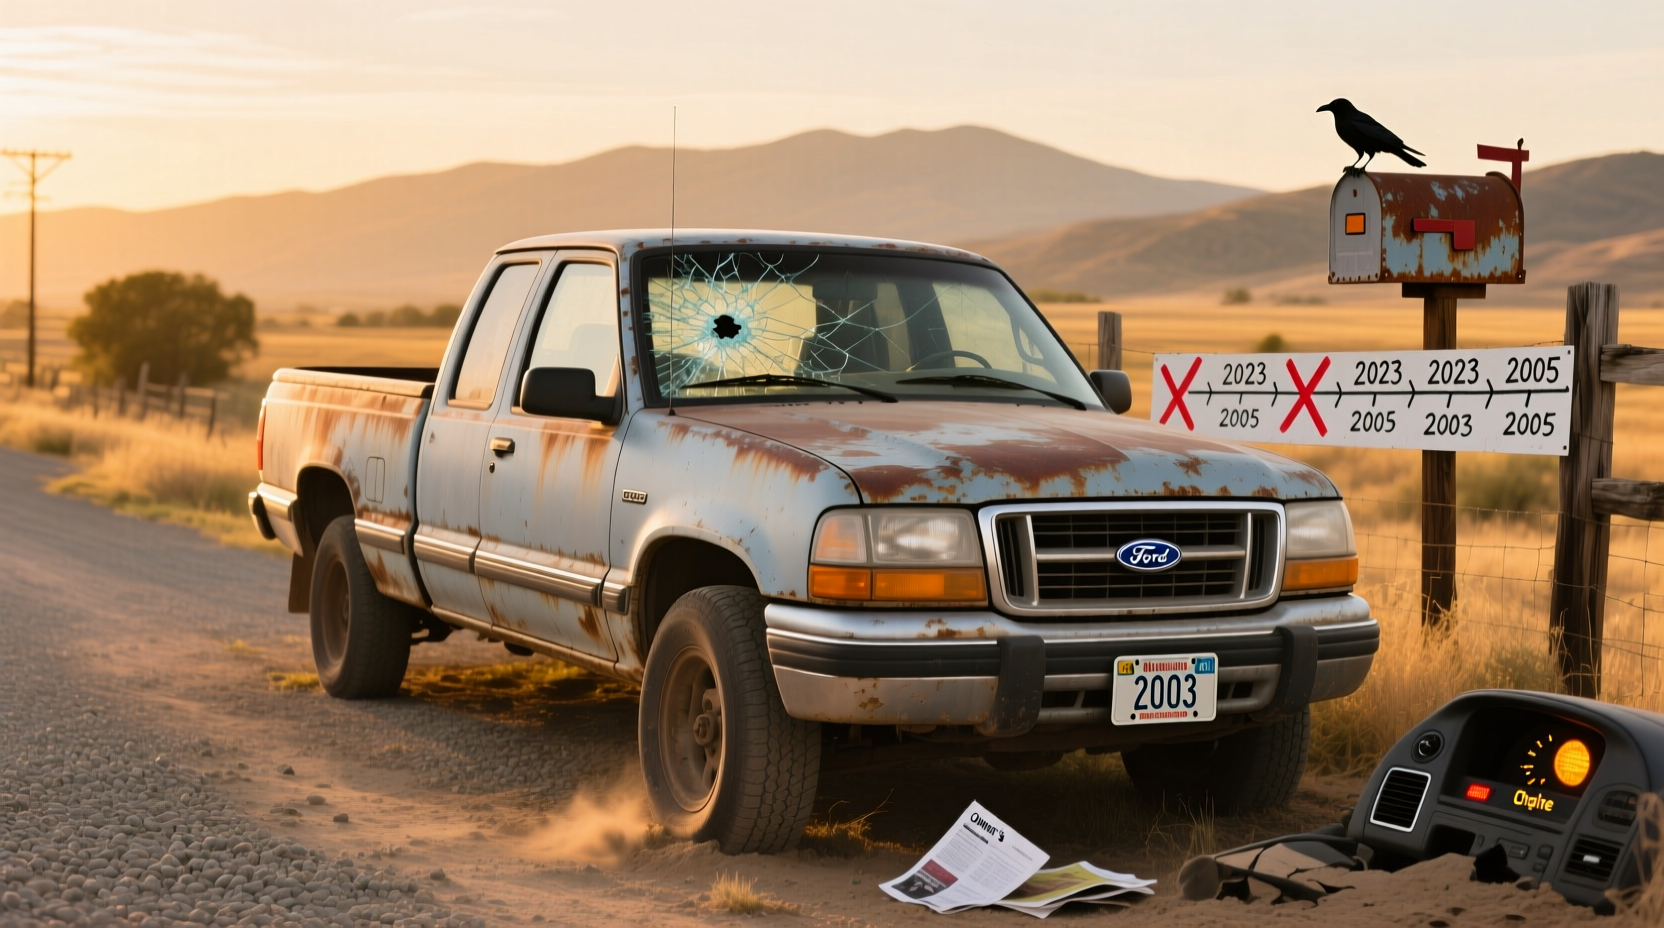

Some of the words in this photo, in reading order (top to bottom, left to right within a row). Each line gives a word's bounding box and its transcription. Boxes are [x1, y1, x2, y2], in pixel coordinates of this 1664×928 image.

[1222, 362, 1267, 386] 2023
[1353, 359, 1402, 386] 2023
[1427, 358, 1479, 385] 2023
[1505, 356, 1561, 384] 2005
[1219, 408, 1260, 429] 2005
[1350, 410, 1396, 433] 2005
[1423, 412, 1473, 437] 2003
[1502, 411, 1556, 437] 2005
[1129, 545, 1170, 564] Ford
[1134, 673, 1197, 711] 2003
